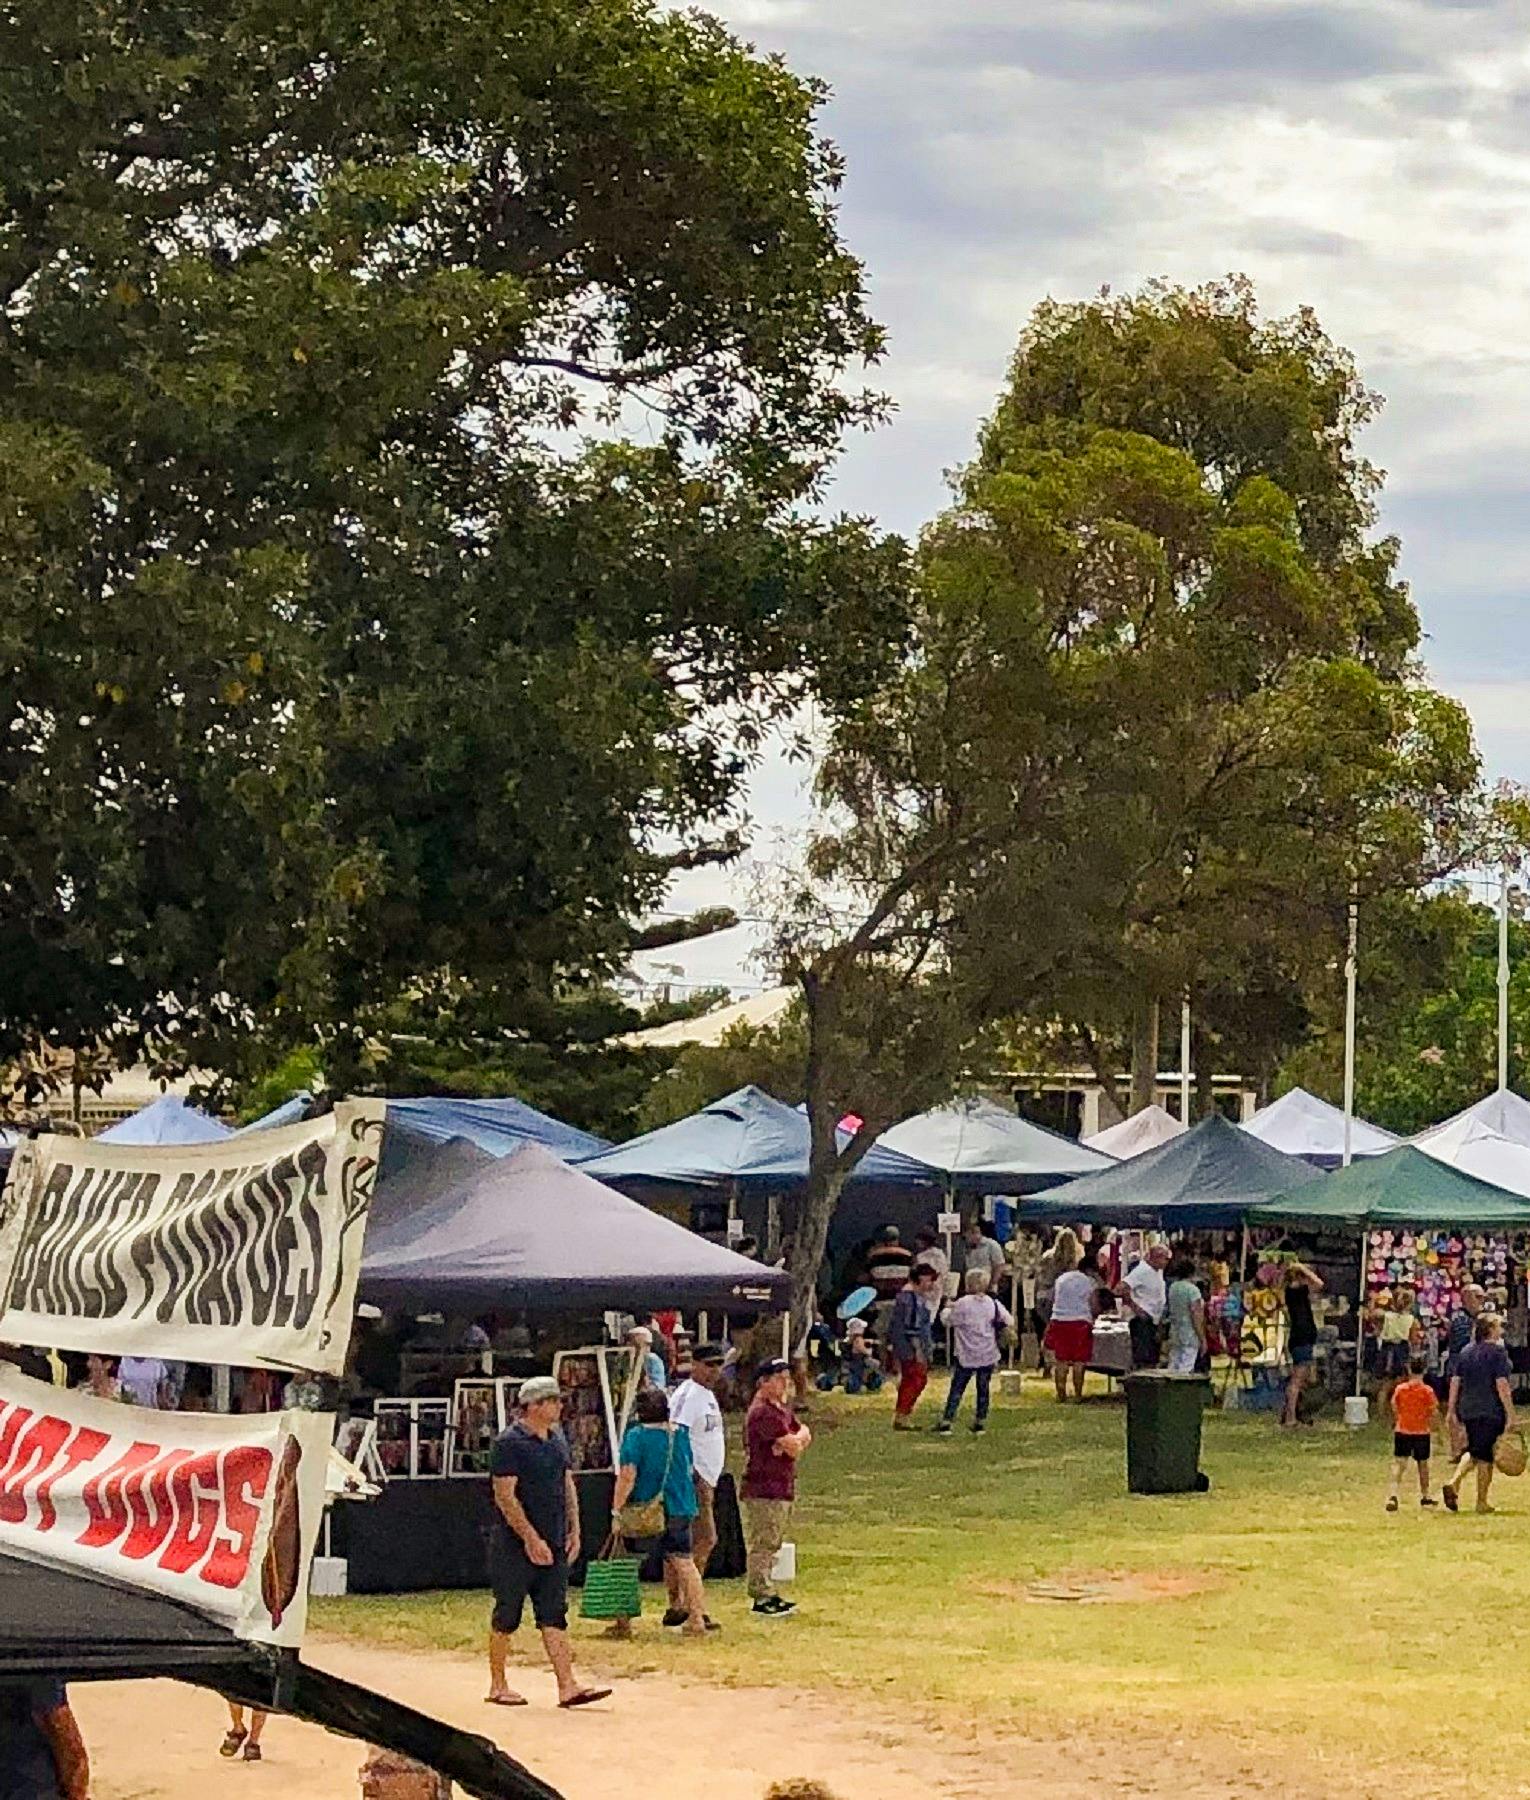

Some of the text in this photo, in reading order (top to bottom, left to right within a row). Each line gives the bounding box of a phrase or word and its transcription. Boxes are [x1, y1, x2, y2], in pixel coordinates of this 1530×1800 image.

[9, 1140, 327, 1330] BAKED POTATOES
[75, 1441, 273, 1588] DOGS
